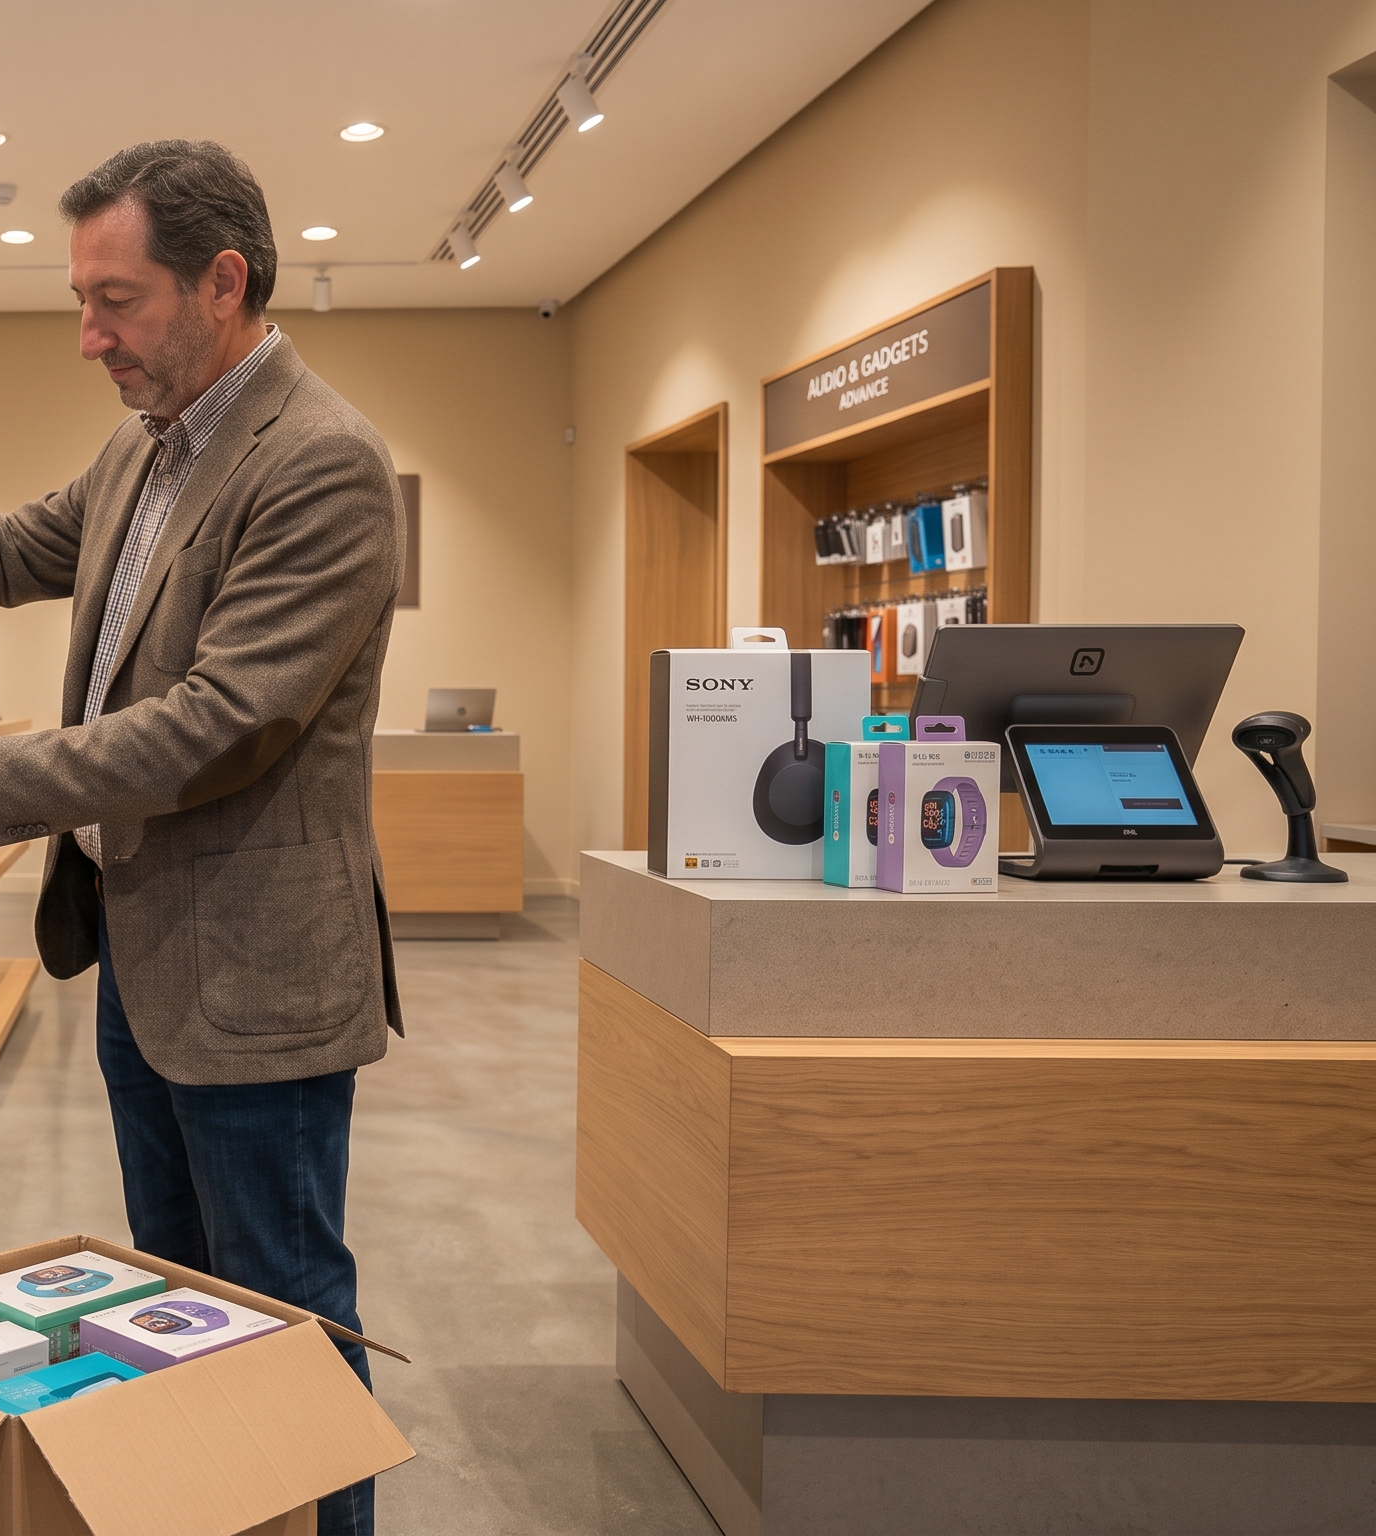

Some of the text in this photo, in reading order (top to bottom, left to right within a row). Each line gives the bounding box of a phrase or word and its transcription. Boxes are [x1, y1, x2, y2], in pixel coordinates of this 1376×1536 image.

[807, 329, 929, 401] AUDIO & GADGETS
[838, 376, 889, 411] ADVANCE
[686, 678, 754, 691] SONY
